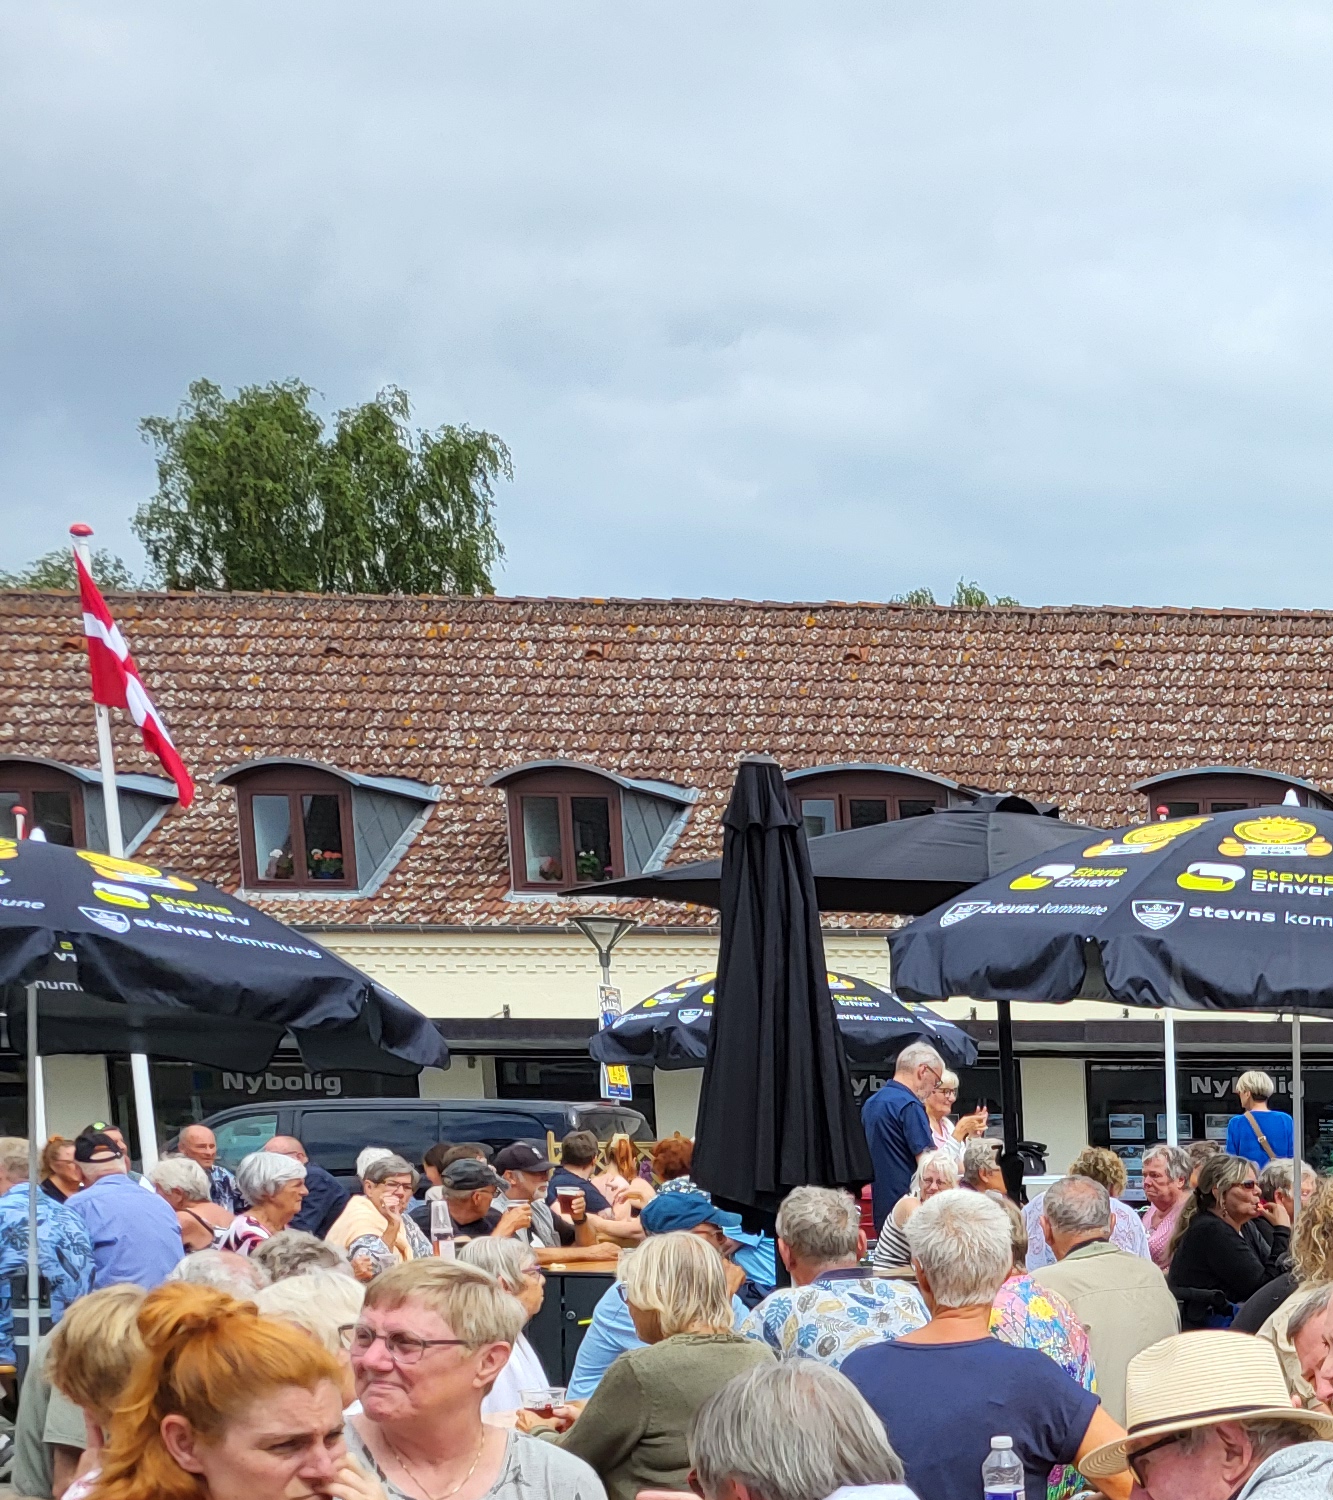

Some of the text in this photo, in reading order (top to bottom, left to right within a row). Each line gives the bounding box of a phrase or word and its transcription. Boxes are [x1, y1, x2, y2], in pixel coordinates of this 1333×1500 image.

[1070, 866, 1128, 877] Stevns
[1054, 877, 1120, 888] Erhverv
[150, 893, 233, 915] Stevns
[981, 901, 1108, 916] stevns kommune
[160, 903, 250, 927] Erhverv
[1188, 905, 1276, 923] stevns
[133, 917, 322, 960] stevns kommune
[836, 1012, 863, 1021] evns
[222, 1072, 342, 1096] Nybolig
